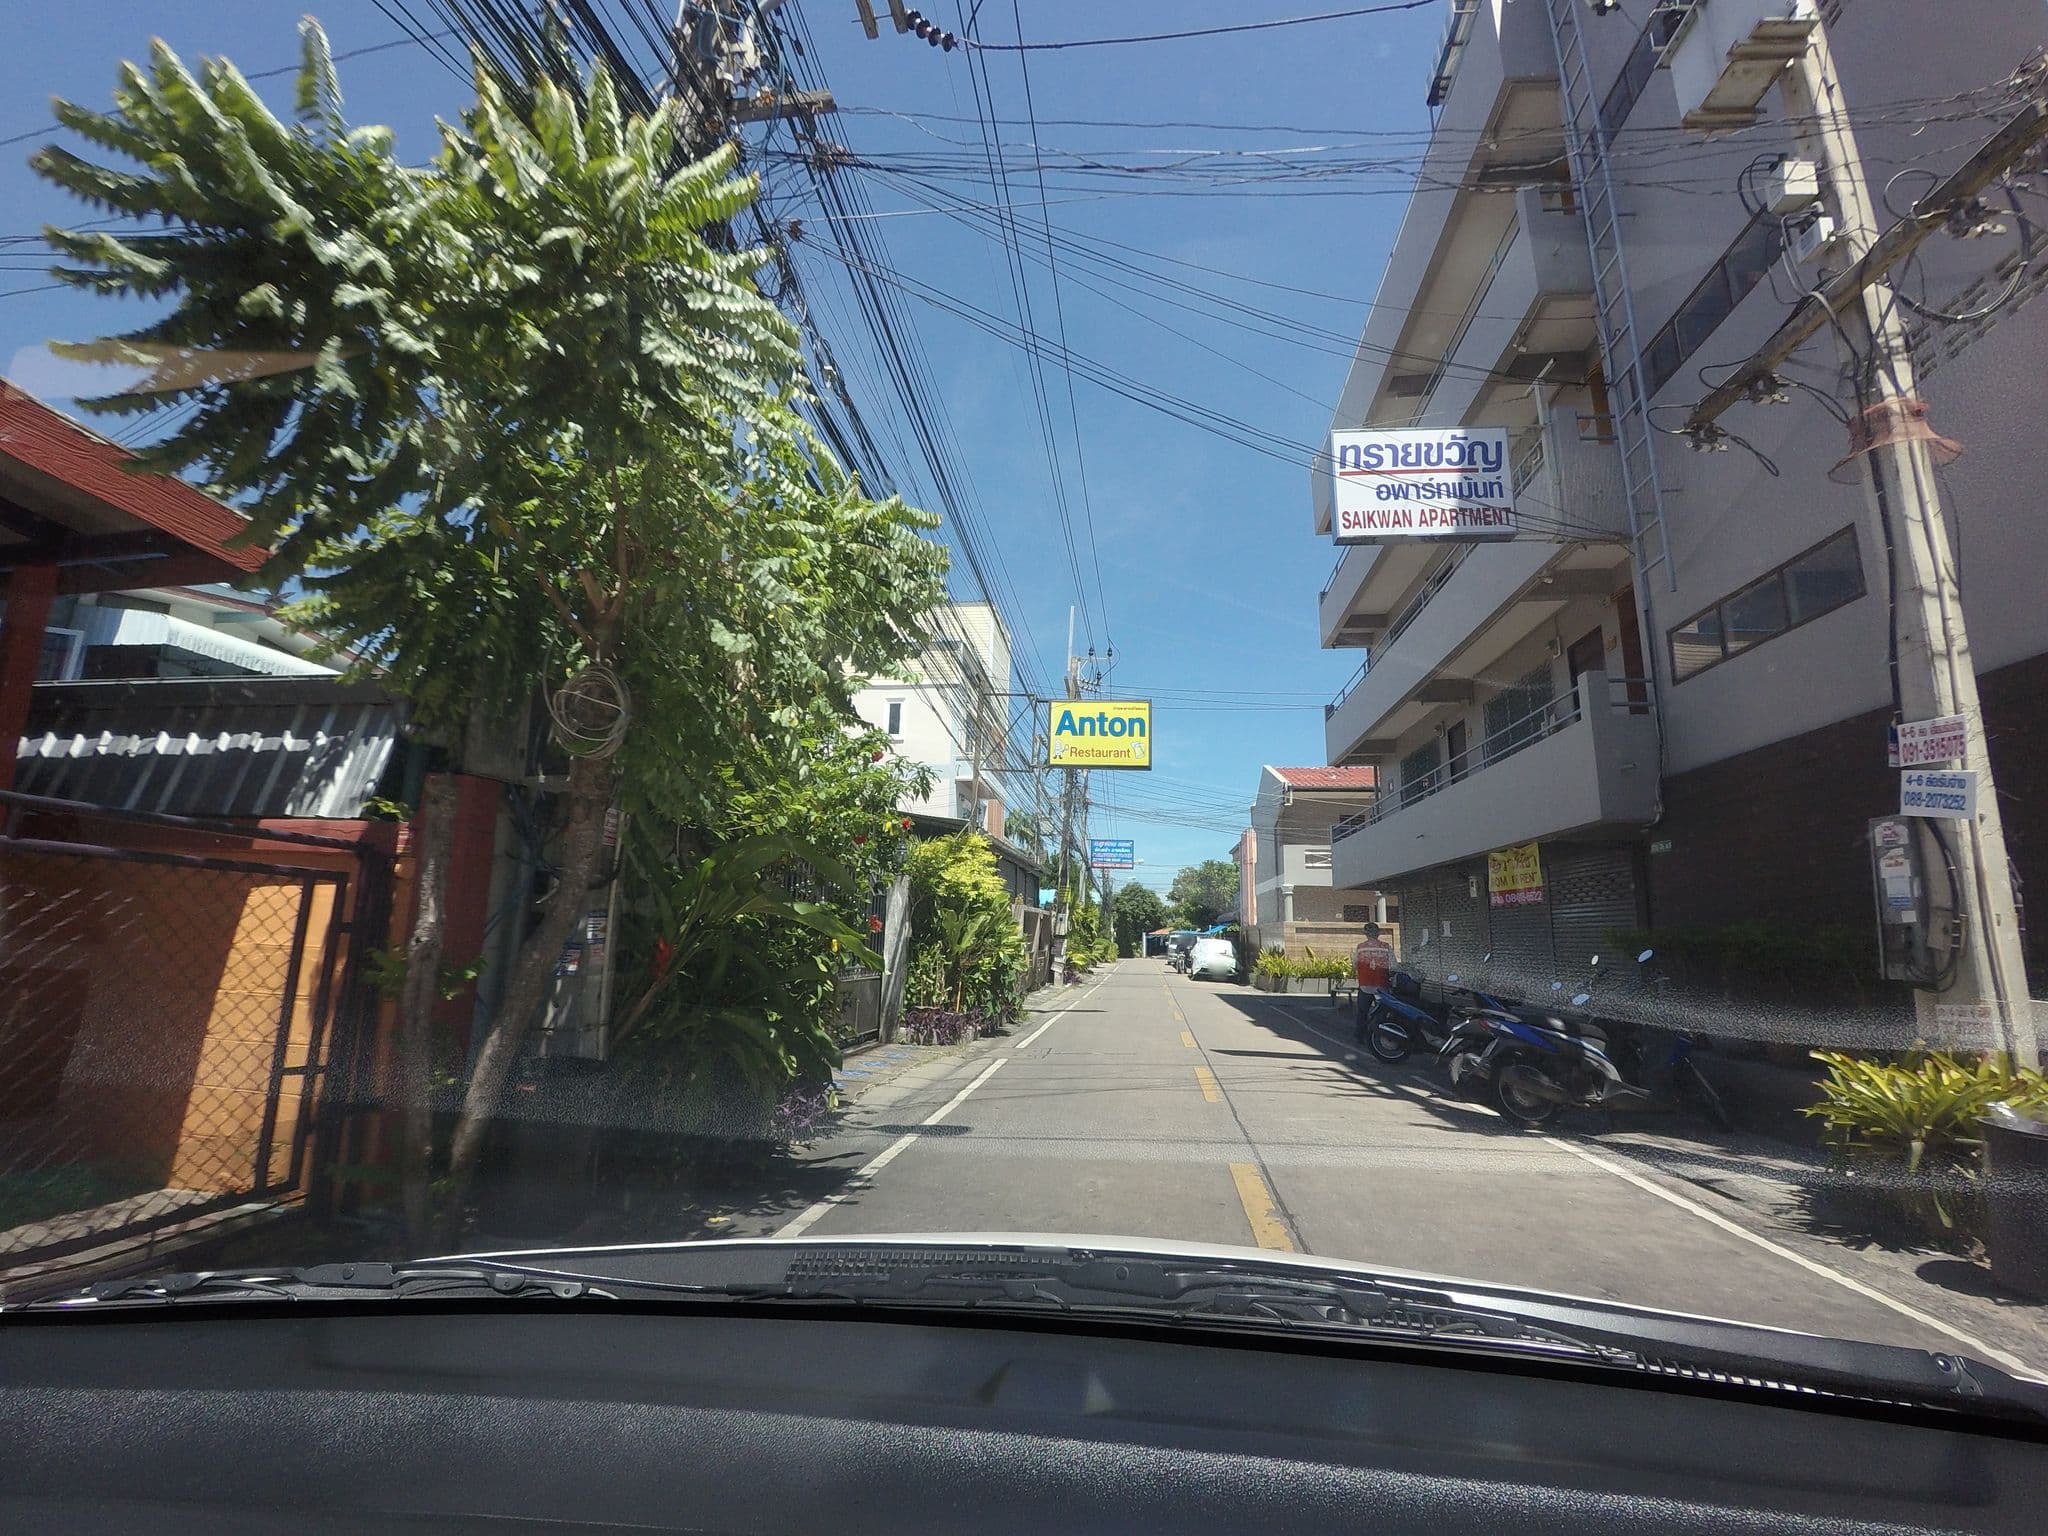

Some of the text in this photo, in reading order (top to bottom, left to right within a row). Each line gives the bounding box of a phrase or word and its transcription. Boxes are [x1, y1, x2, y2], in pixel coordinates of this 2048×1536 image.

[1339, 434, 1503, 473] ทรายขวัญ
[1341, 507, 1512, 530] SAIKWAN APARTMENT
[1055, 709, 1146, 738] Anton
[1069, 746, 1131, 759] Restaurant
[1906, 774, 1924, 786] 4-6
